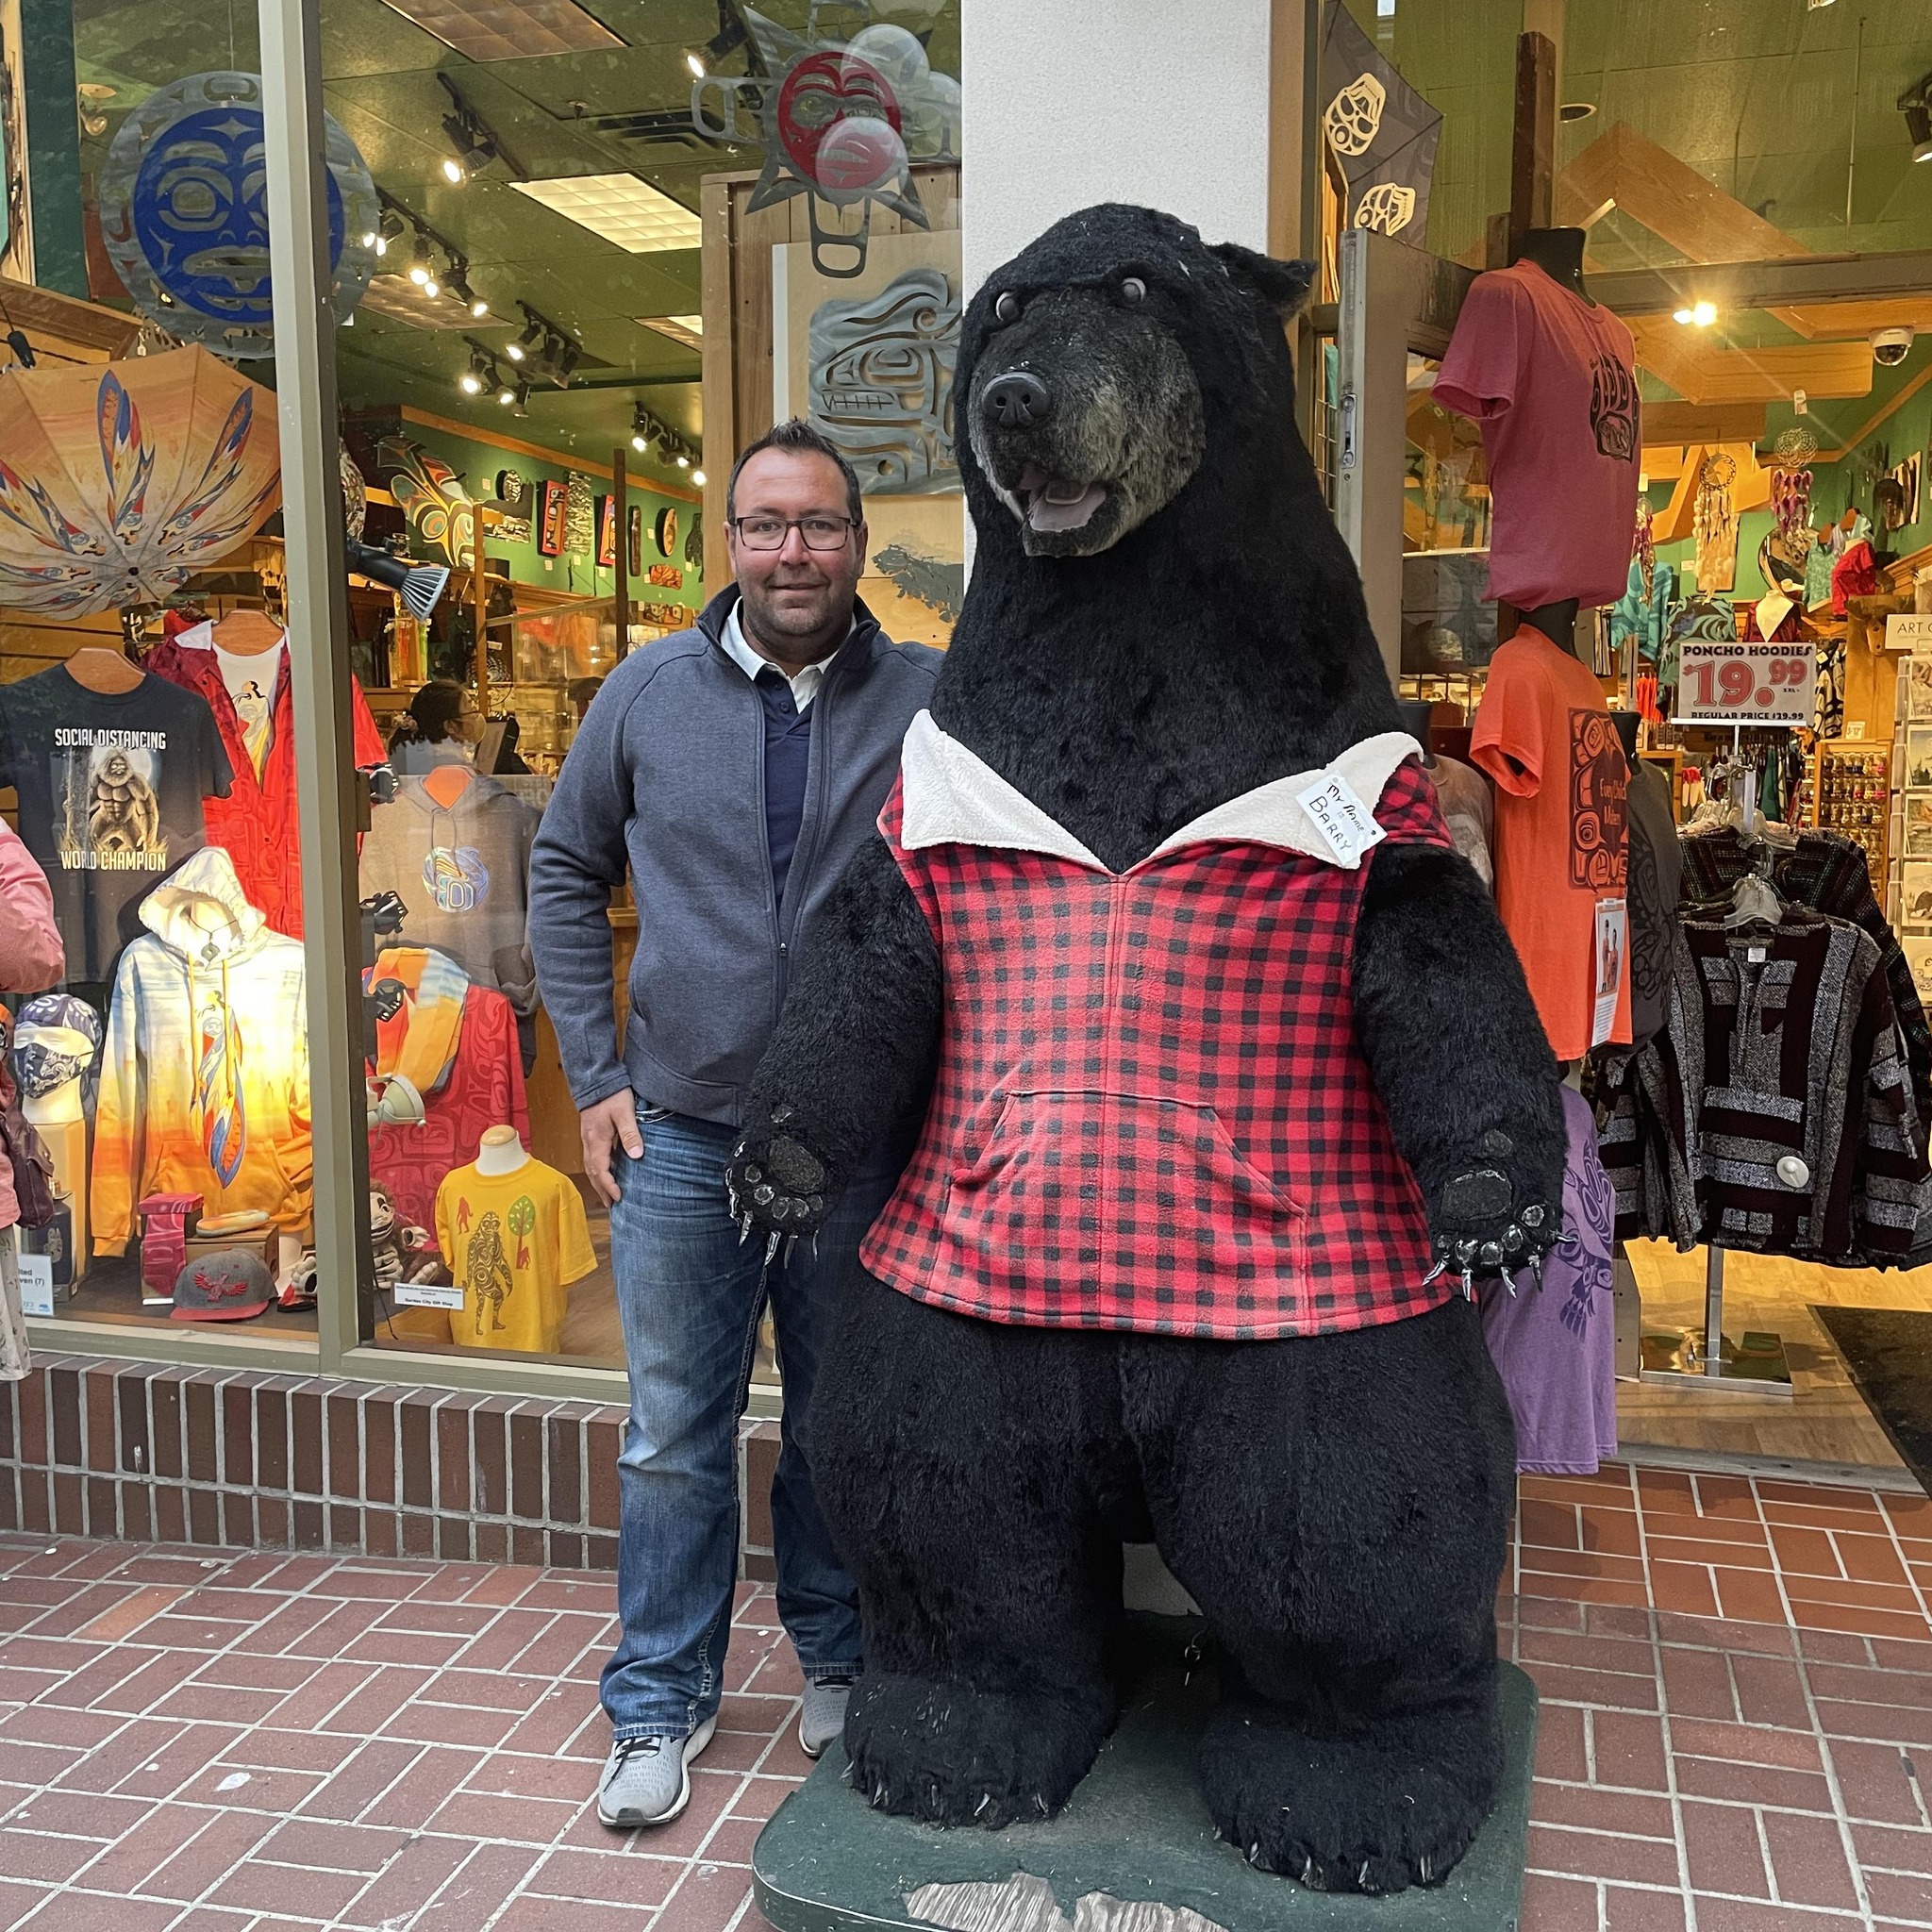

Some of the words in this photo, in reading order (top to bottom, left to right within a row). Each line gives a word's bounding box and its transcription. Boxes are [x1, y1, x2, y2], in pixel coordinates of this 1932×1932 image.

[1897, 622, 1924, 633] ART
[1683, 645, 1744, 657] PONCHO
[1749, 645, 1812, 657] HOODIES
[1691, 711, 1738, 720] REGULAR
[55, 728, 94, 747] SOCIAL
[97, 729, 166, 750] DISTANCING
[1308, 795, 1352, 850] BARRY
[60, 850, 96, 870] WORLD
[100, 851, 166, 872] CHAMPION
[34, 1277, 45, 1287] (7)
